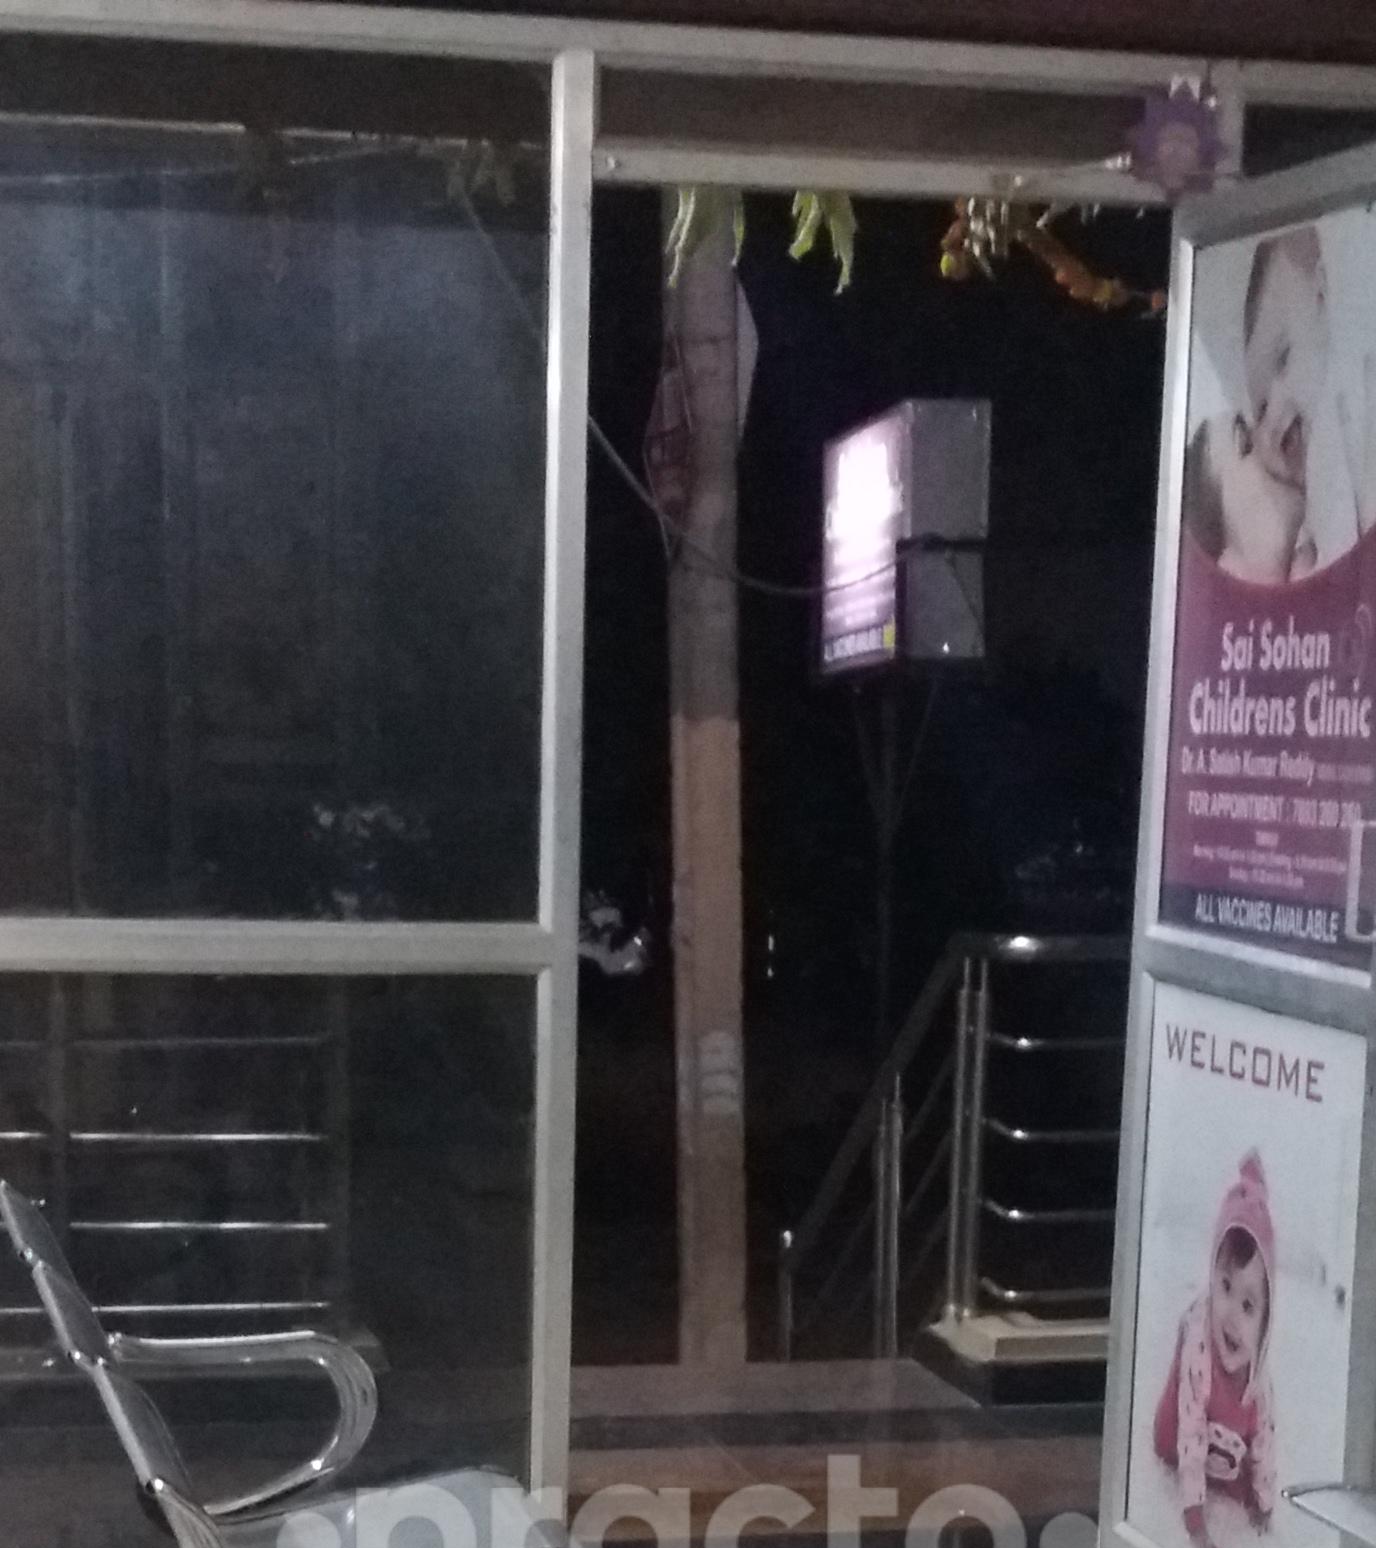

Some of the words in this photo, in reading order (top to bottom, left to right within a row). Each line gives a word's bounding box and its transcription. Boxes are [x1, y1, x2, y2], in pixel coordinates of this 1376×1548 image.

[1221, 618, 1254, 671] Sai
[1259, 615, 1331, 671] Sohan
[1189, 677, 1296, 735] Childrens
[1304, 674, 1372, 738] Clinic
[1188, 790, 1210, 817] FOR
[1210, 792, 1285, 823] APPOINTMENT
[1194, 893, 1215, 924] ALL
[1217, 895, 1272, 932] VACCINES
[1273, 902, 1341, 944] AVAILABLE
[1165, 1023, 1325, 1103] WELCOME
